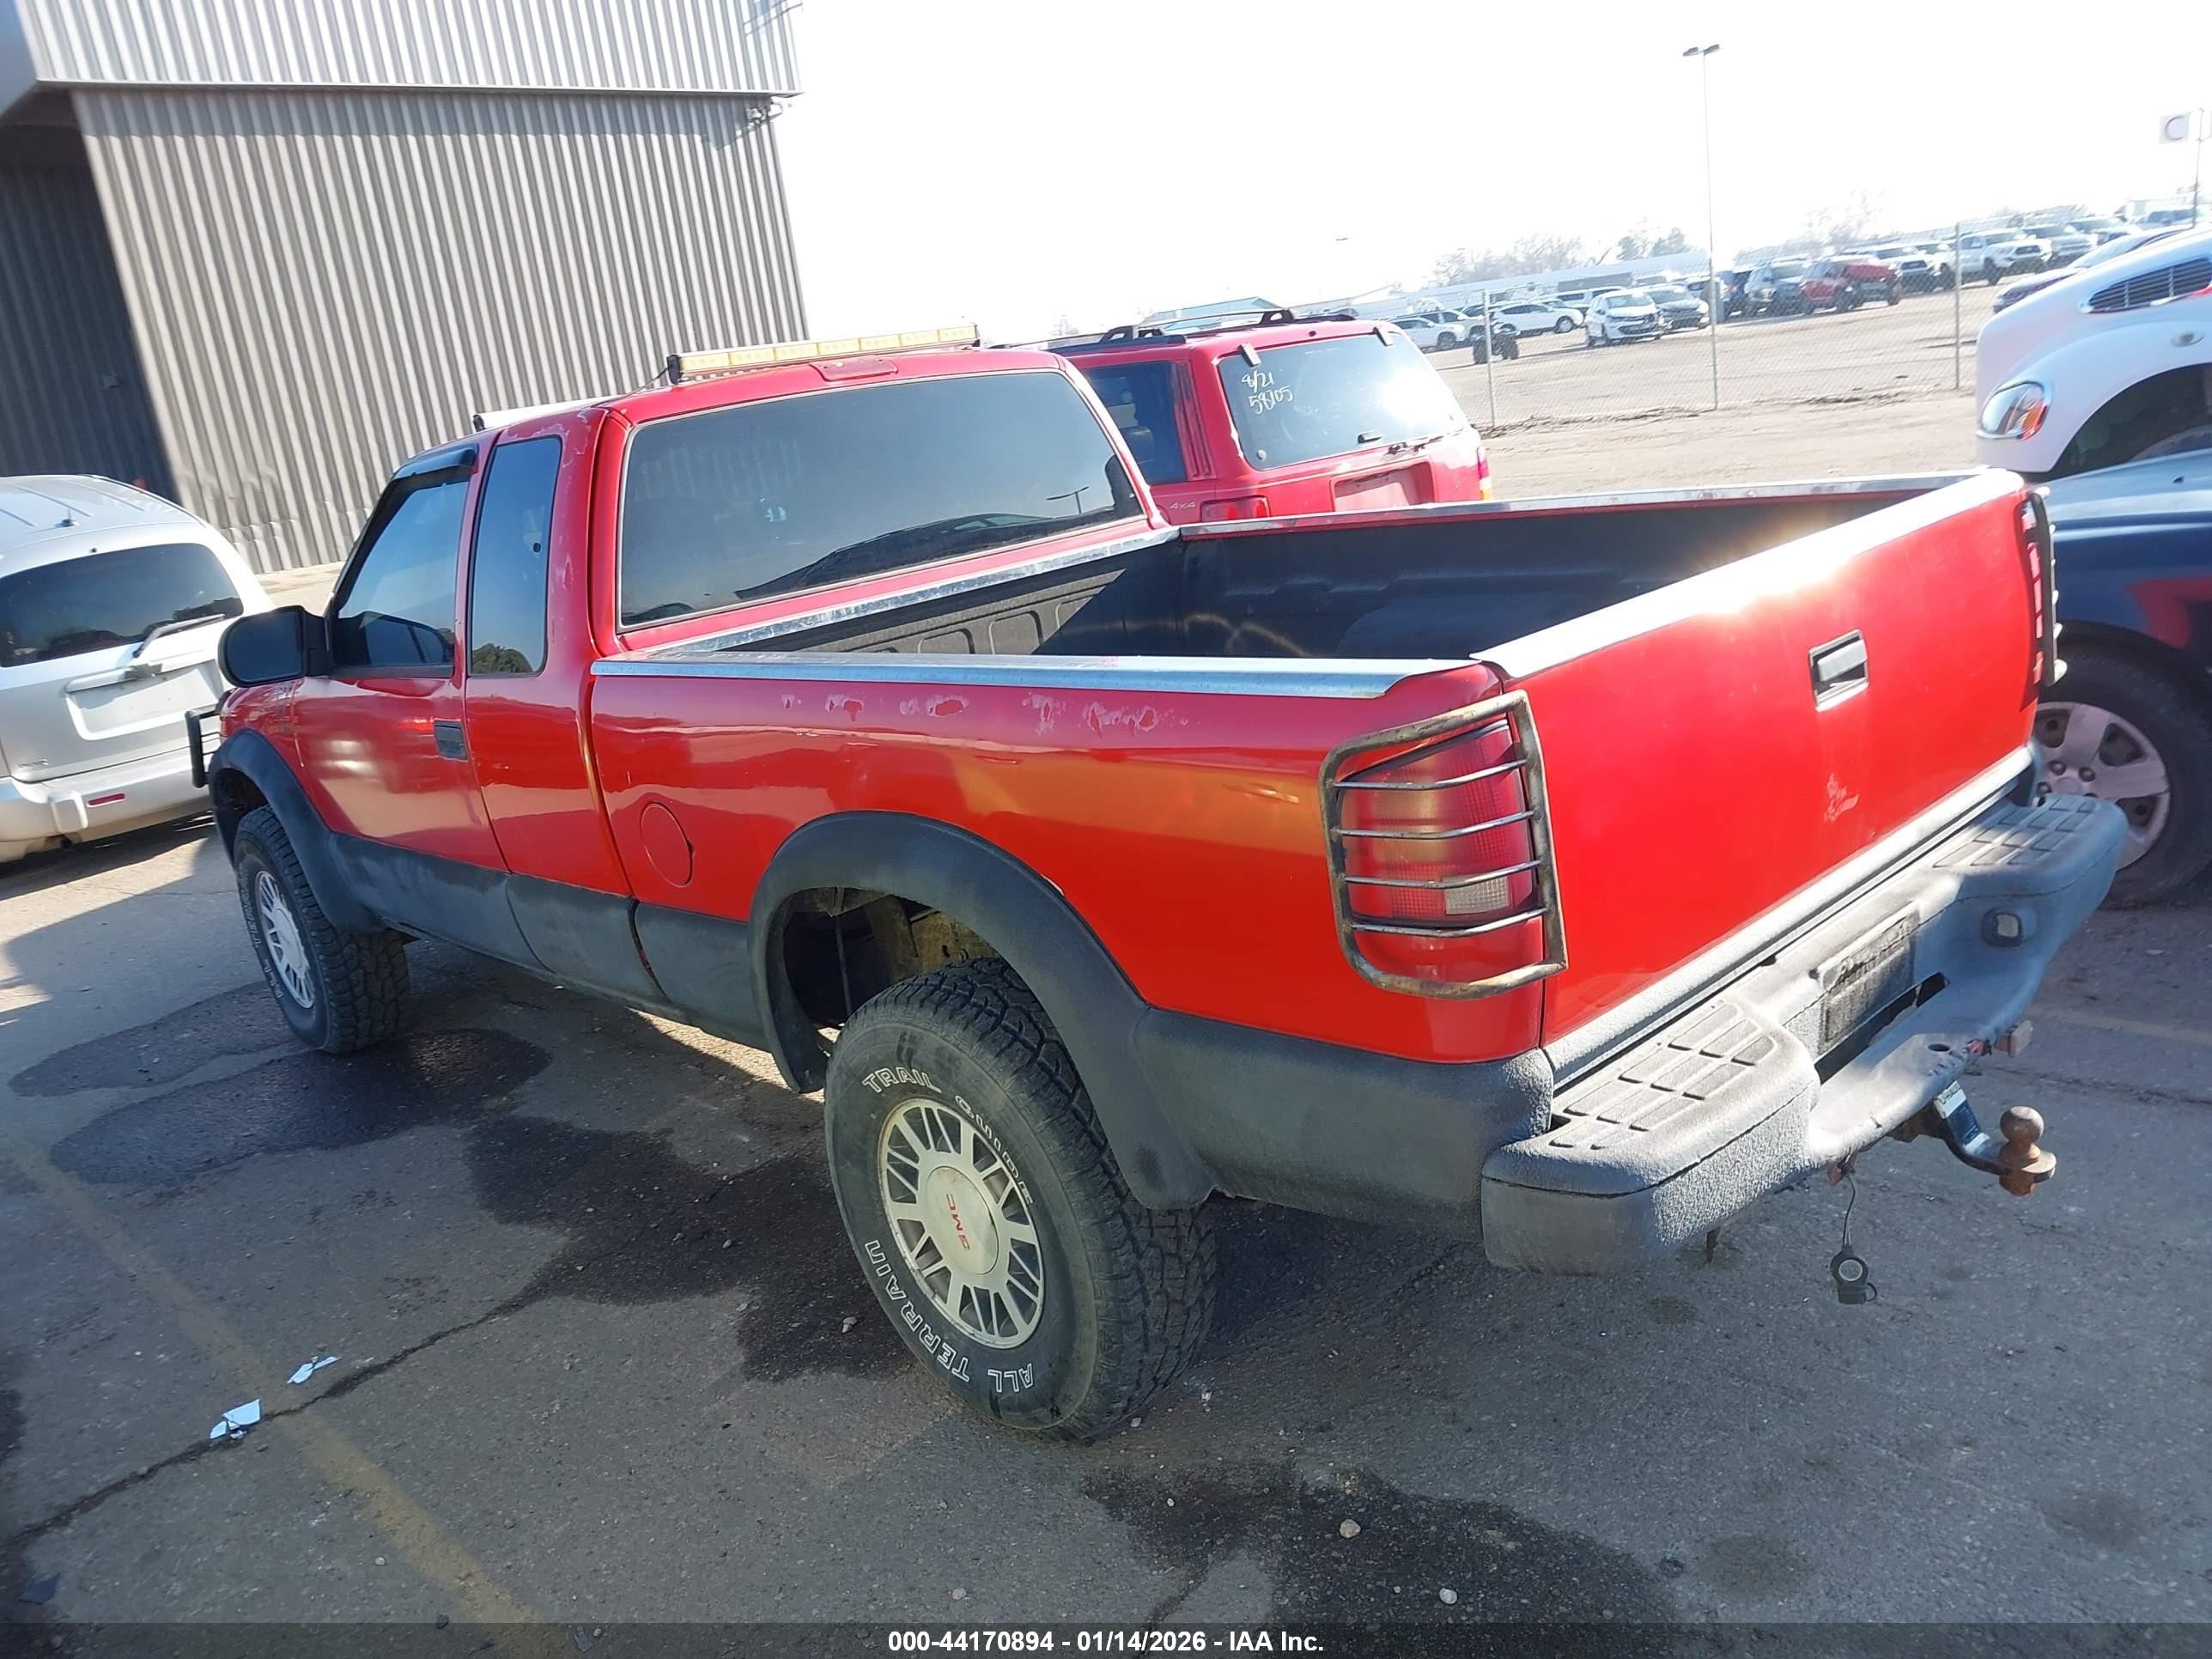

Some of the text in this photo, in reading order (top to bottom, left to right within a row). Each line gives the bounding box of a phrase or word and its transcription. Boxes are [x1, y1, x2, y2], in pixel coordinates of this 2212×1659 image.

[861, 1066, 1034, 1205] TRAIL GUIDE
[945, 1194, 971, 1251] GMC
[864, 1239, 1034, 1393] ALL TERRAIN
